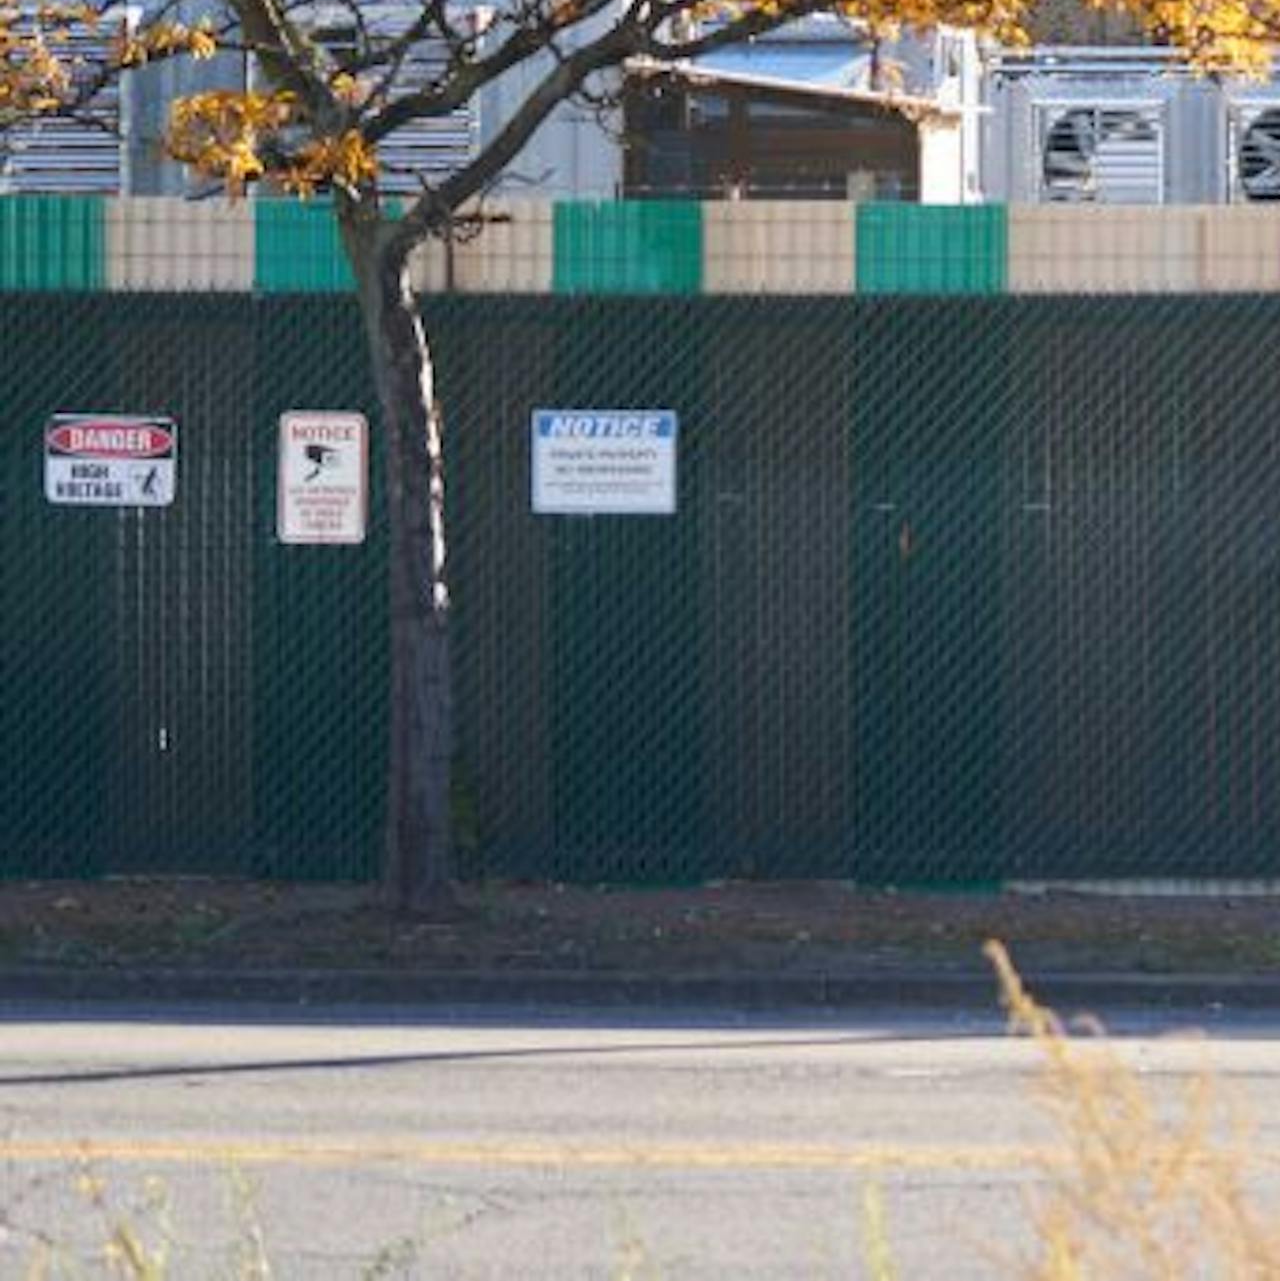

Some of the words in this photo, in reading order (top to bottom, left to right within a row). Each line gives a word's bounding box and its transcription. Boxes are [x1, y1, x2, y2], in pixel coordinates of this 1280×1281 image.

[292, 424, 357, 440] NOTICE
[549, 416, 662, 437] NOTICE
[70, 428, 152, 451] DANGER
[71, 463, 110, 479] HIGH
[56, 481, 121, 498] VOLTAGE
